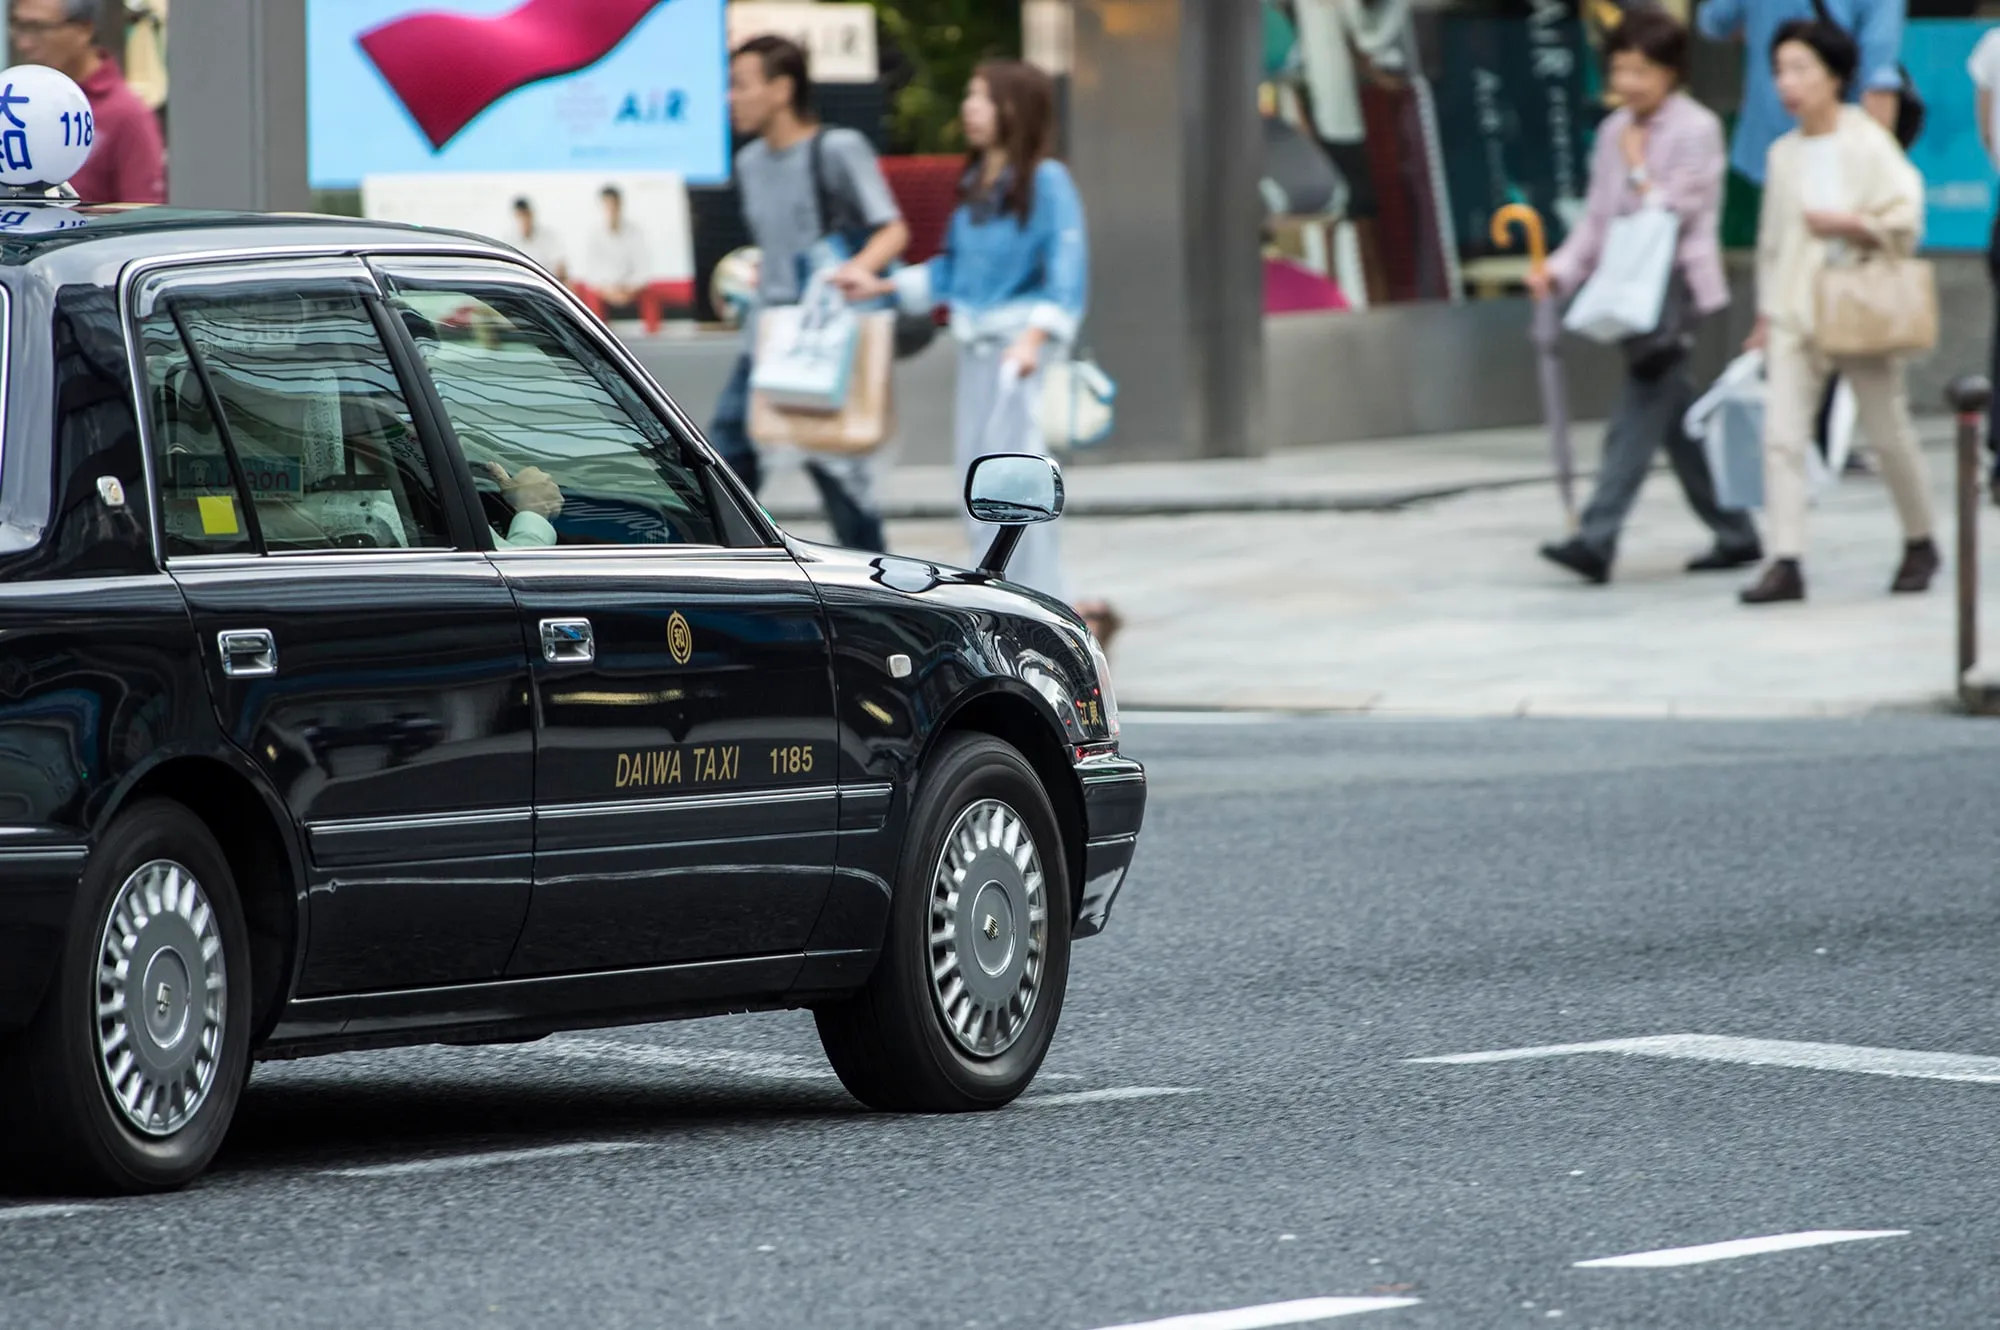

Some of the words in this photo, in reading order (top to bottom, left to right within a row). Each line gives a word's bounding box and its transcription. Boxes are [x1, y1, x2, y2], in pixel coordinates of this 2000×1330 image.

[615, 750, 682, 788] DAIWA
[693, 745, 740, 782] TAXI
[769, 745, 813, 775] 1185
